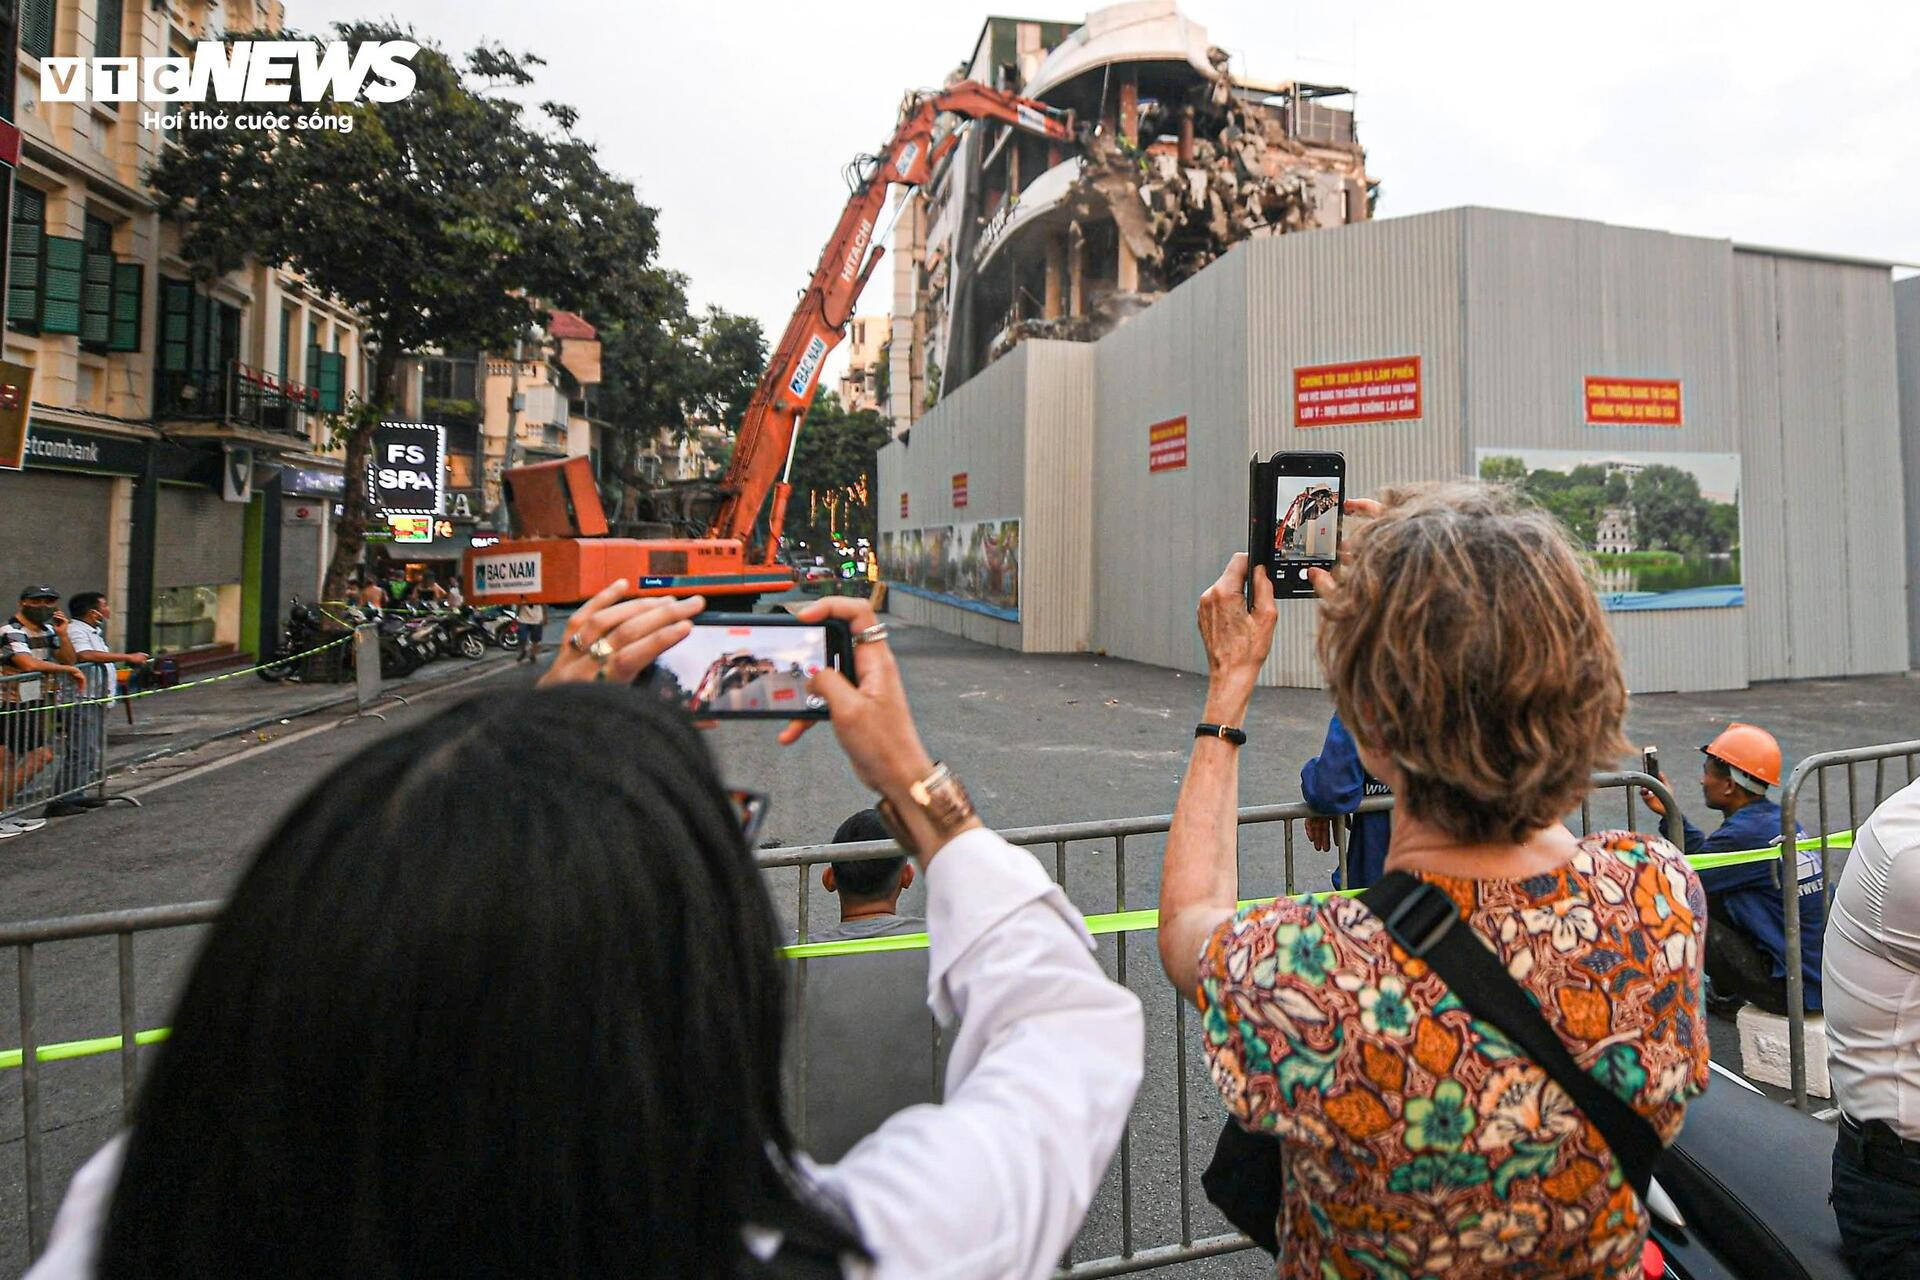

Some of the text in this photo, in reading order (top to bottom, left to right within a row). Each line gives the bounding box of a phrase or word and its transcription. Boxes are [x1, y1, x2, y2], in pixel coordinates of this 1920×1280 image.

[841, 218, 872, 282] HITACHI
[387, 444, 426, 465] FS
[378, 469, 435, 491] SPA
[509, 561, 535, 578] NAM
